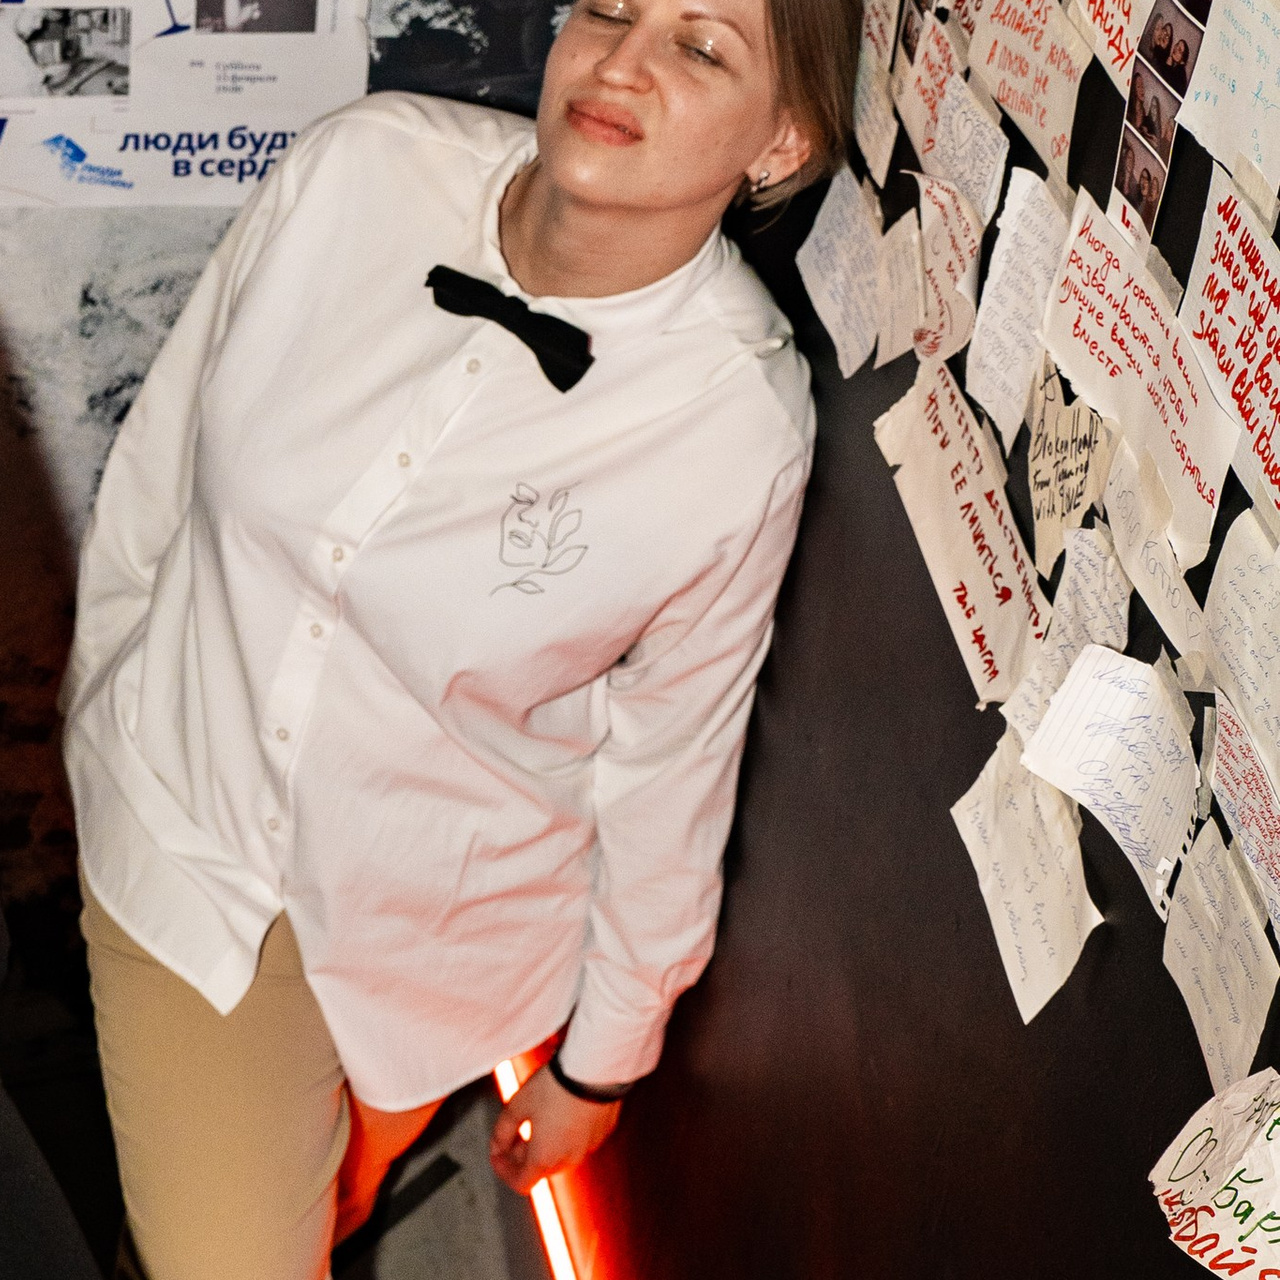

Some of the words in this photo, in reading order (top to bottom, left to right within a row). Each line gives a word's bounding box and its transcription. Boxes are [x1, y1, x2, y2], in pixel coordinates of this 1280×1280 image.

[119, 127, 219, 158] люди
[227, 124, 299, 155] буд
[172, 158, 192, 177] в
[1059, 276, 1105, 327] лучшие
[1111, 322, 1143, 378] вещи
[1078, 214, 1120, 303] Иногда
[1123, 274, 1170, 340] хорошие
[1172, 331, 1199, 408] вещи
[960, 502, 1013, 606] ЛИШИТЬСЯ
